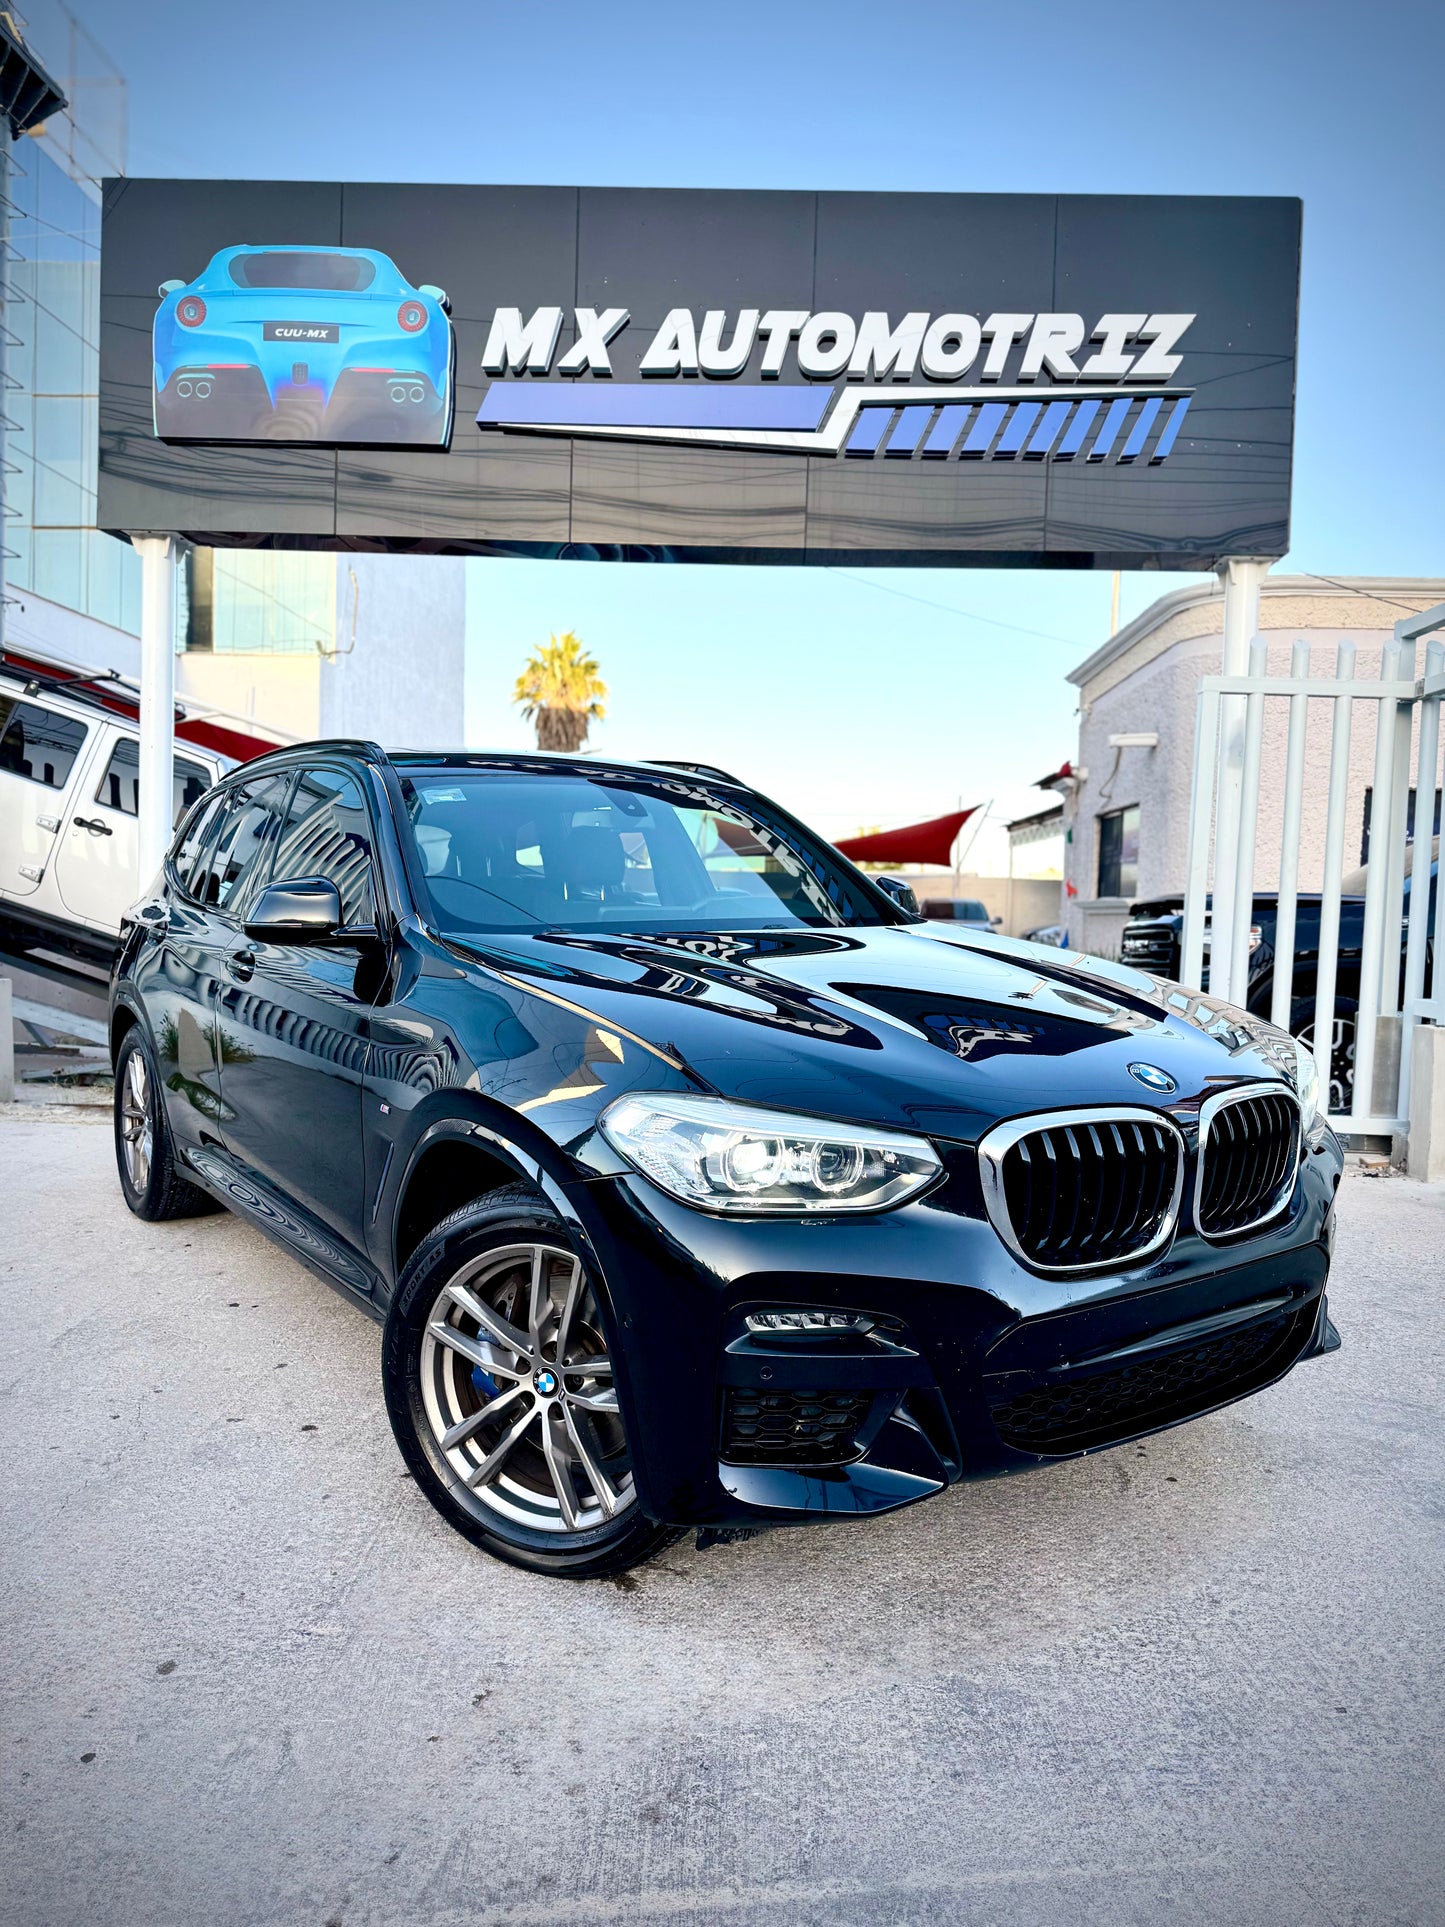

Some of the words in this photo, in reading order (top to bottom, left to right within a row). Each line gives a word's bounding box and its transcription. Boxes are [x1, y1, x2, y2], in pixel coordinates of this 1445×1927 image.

[274, 328, 329, 339] CUU-MX
[481, 307, 631, 374] MX
[639, 308, 1197, 380] AUTOMOTRIZ
